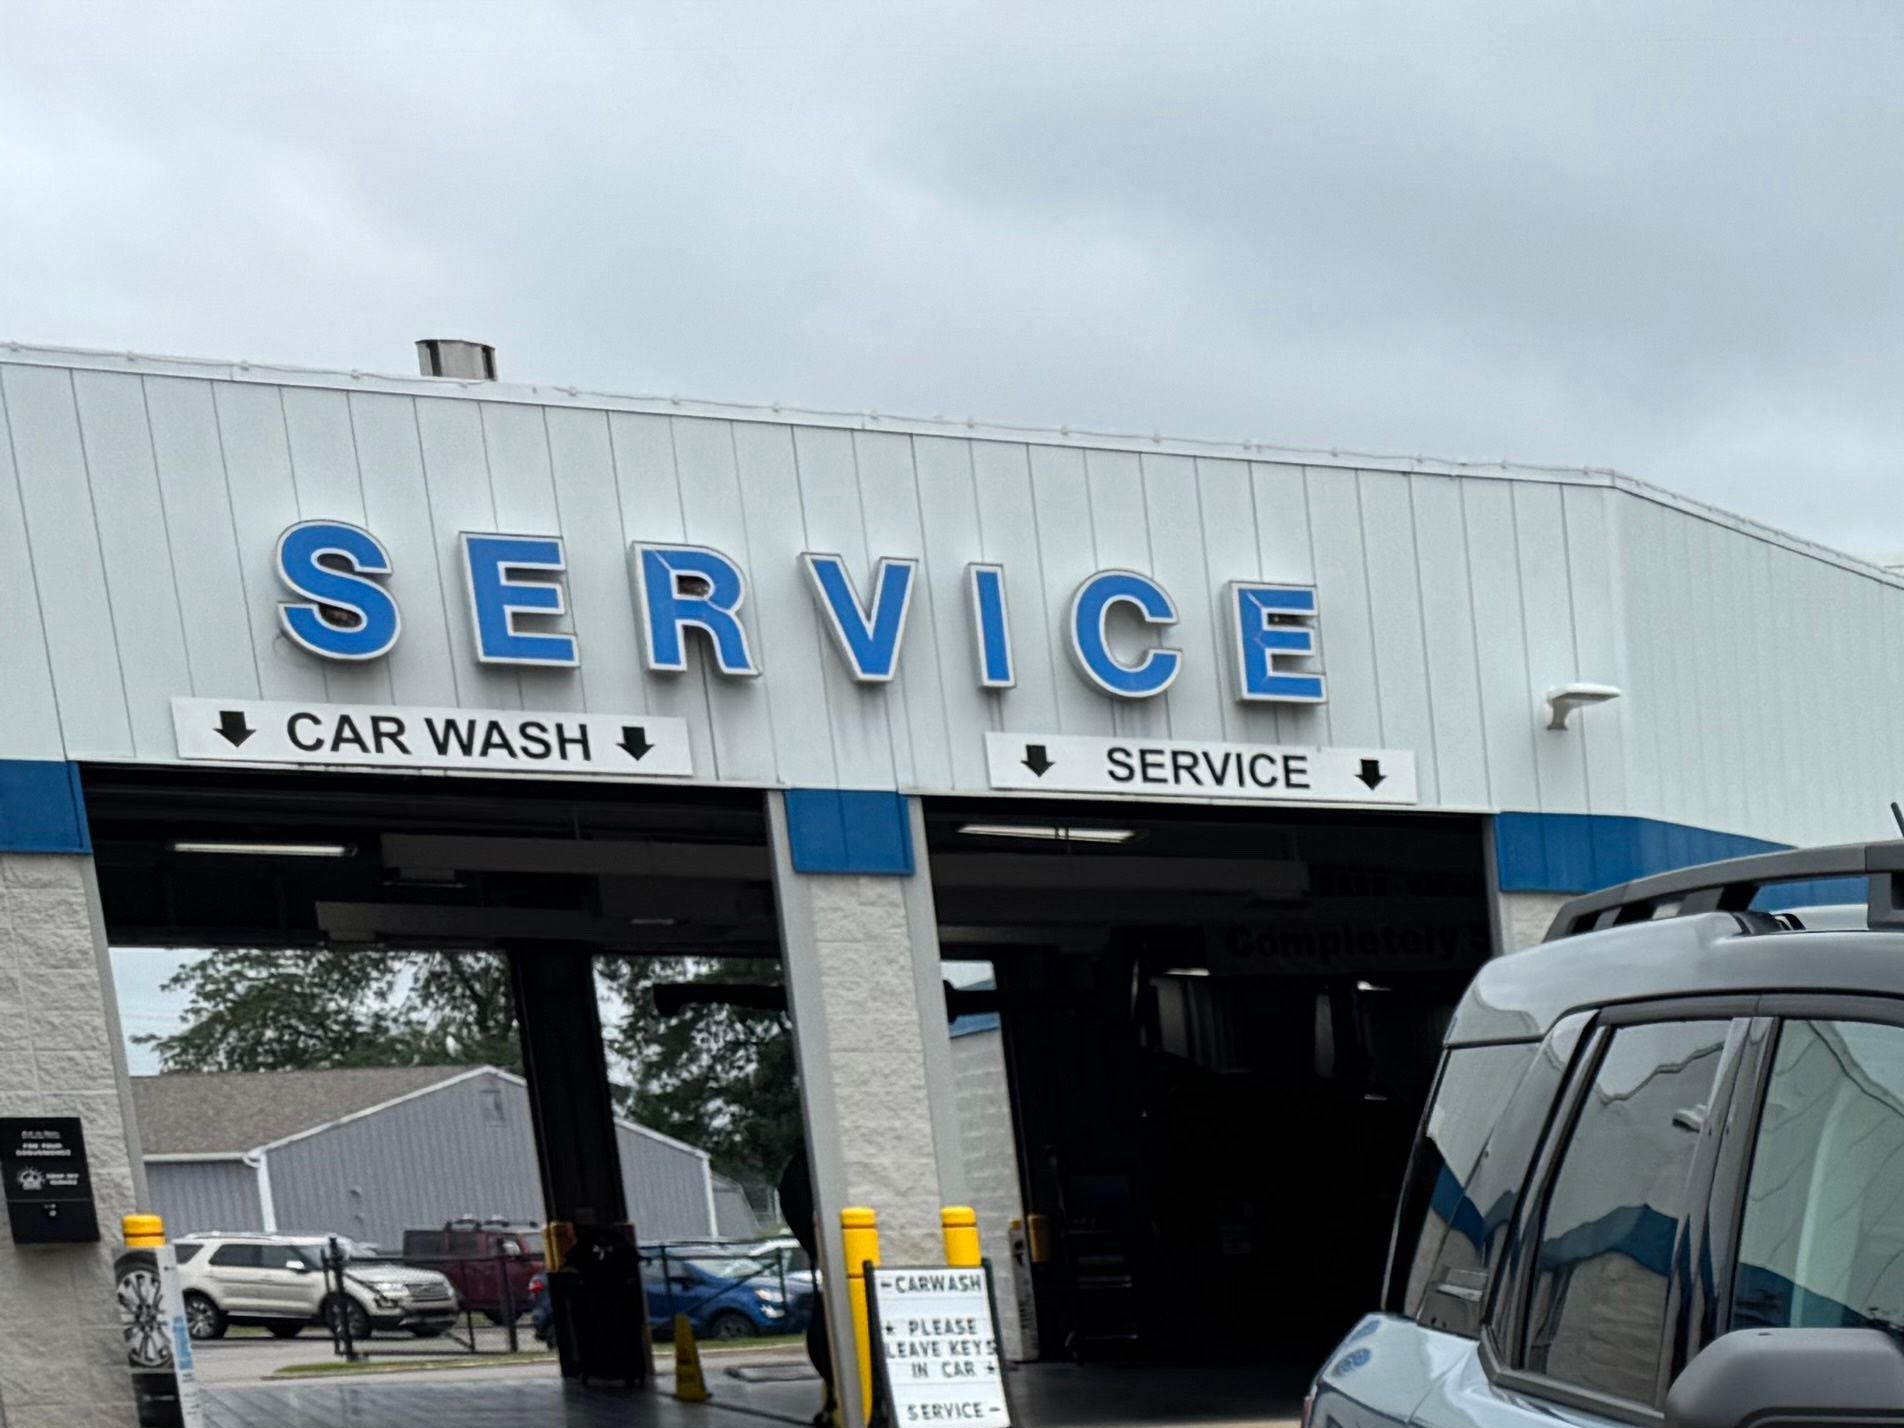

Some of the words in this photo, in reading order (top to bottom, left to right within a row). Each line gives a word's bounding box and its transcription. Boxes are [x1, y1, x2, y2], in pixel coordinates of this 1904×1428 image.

[276, 518, 1329, 705] SERVICE
[286, 711, 412, 756] CAR
[423, 716, 592, 761] WASH
[1106, 746, 1311, 790] SERVICE
[909, 1318, 977, 1335] PLEASE
[886, 1341, 941, 1358] LEAVE
[949, 1340, 997, 1356] KEYS
[912, 1362, 929, 1377] IN
[942, 1361, 976, 1377] CAR
